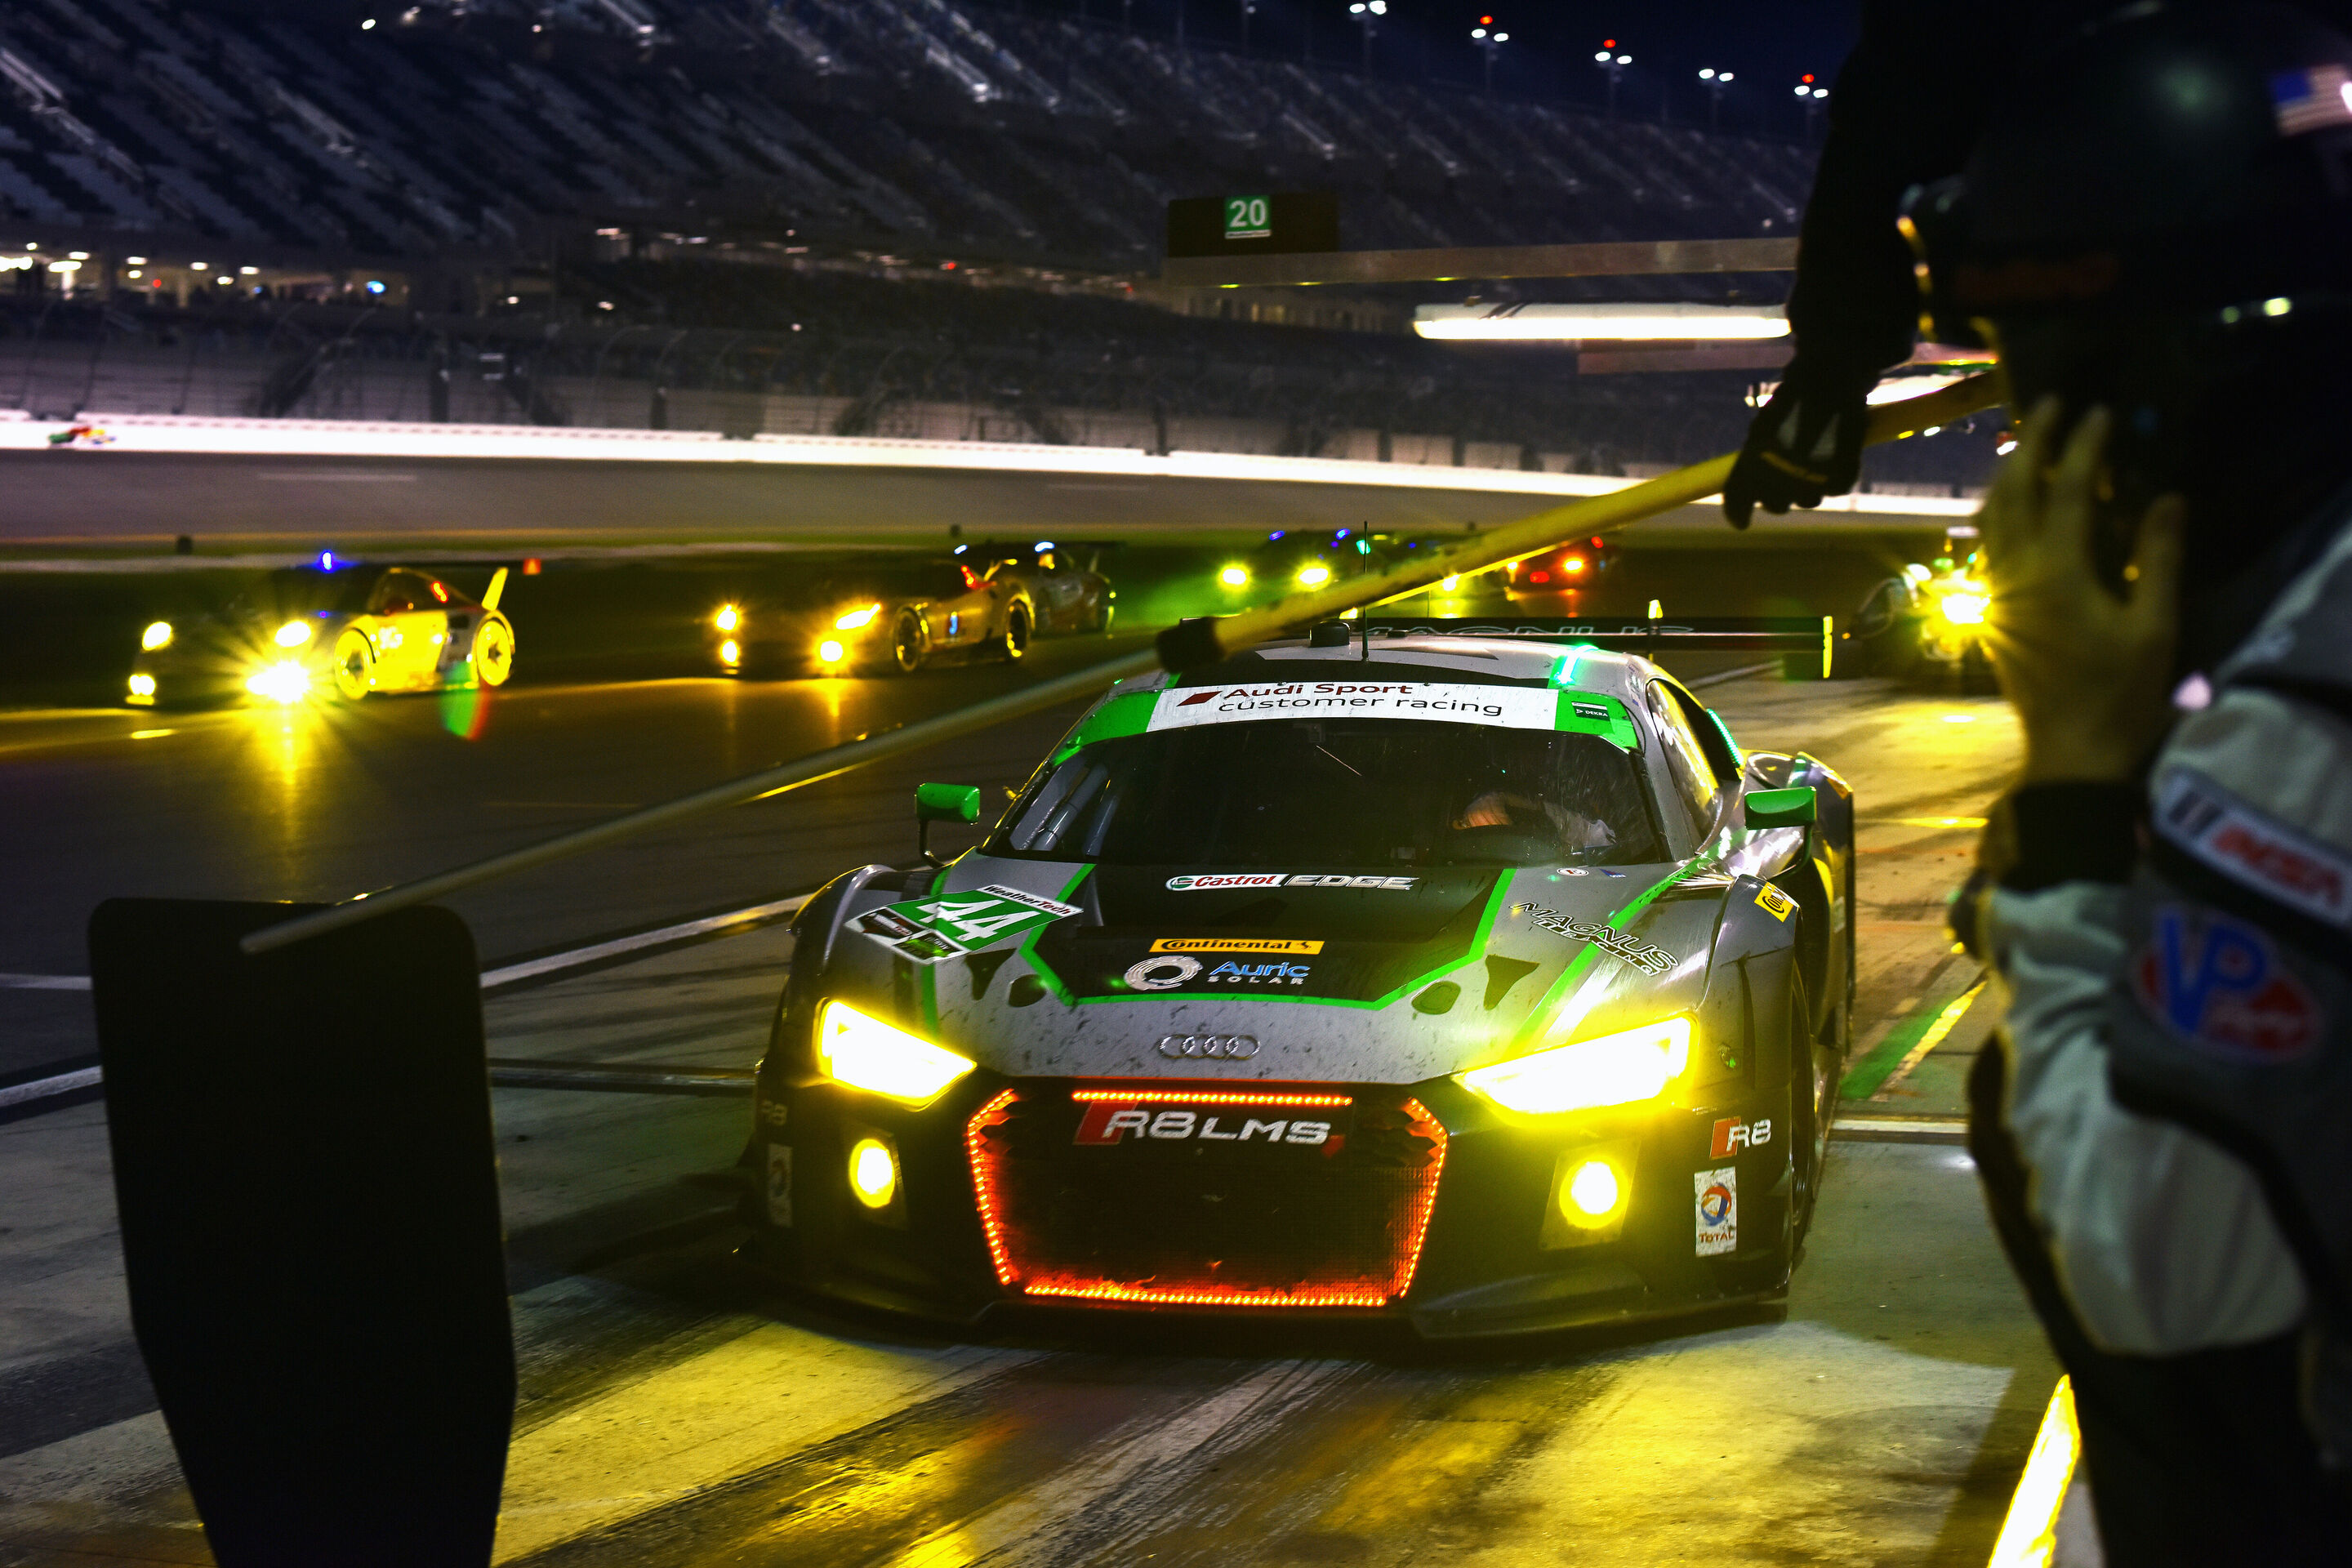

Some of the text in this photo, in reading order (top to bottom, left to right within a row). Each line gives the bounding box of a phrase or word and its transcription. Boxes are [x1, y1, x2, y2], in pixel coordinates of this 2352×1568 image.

[1229, 199, 1267, 227] 20
[1224, 683, 1414, 699] Audi Sport
[1218, 697, 1503, 716] customer racing
[1194, 875, 1419, 890] Castrol EDGE
[983, 885, 1071, 915] WeatherTech
[915, 900, 1041, 941] 44
[1160, 939, 1291, 951] Continental
[1508, 901, 1680, 971] MAGNUS
[1209, 960, 1312, 977] Auric
[2154, 908, 2268, 1034] VP
[1207, 976, 1305, 985] SOLAR
[1102, 1110, 1332, 1145] R8 LMS
[1726, 1118, 1771, 1152] R8
[1698, 1230, 1734, 1244] TOTAL
